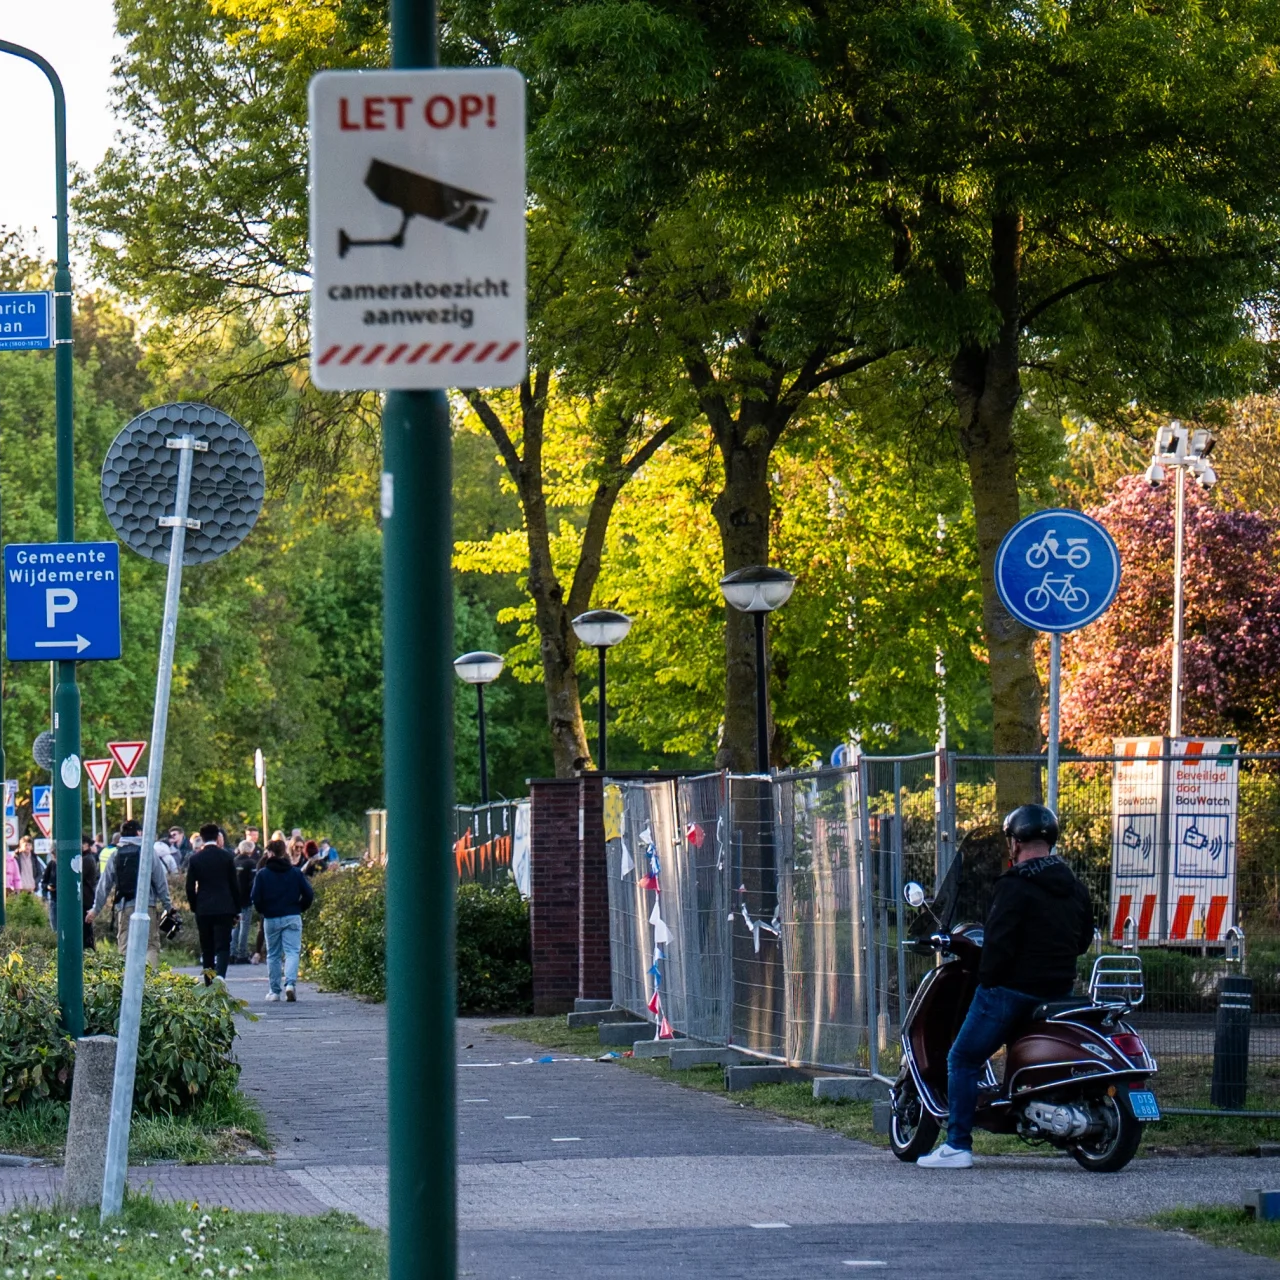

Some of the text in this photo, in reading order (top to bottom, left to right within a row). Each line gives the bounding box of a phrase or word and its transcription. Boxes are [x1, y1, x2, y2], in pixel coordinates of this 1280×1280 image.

[339, 94, 498, 131] LET OP!
[327, 278, 510, 301] cameratoezicht
[362, 304, 475, 329] aanwezig
[16, 549, 106, 565] Gemeente
[9, 568, 115, 587] Wijdemeren
[45, 588, 78, 628] P
[1176, 770, 1226, 783] Beveiligd
[1176, 783, 1201, 793] door
[1117, 796, 1158, 806] BouWatch
[1175, 795, 1230, 806] BouWatch
